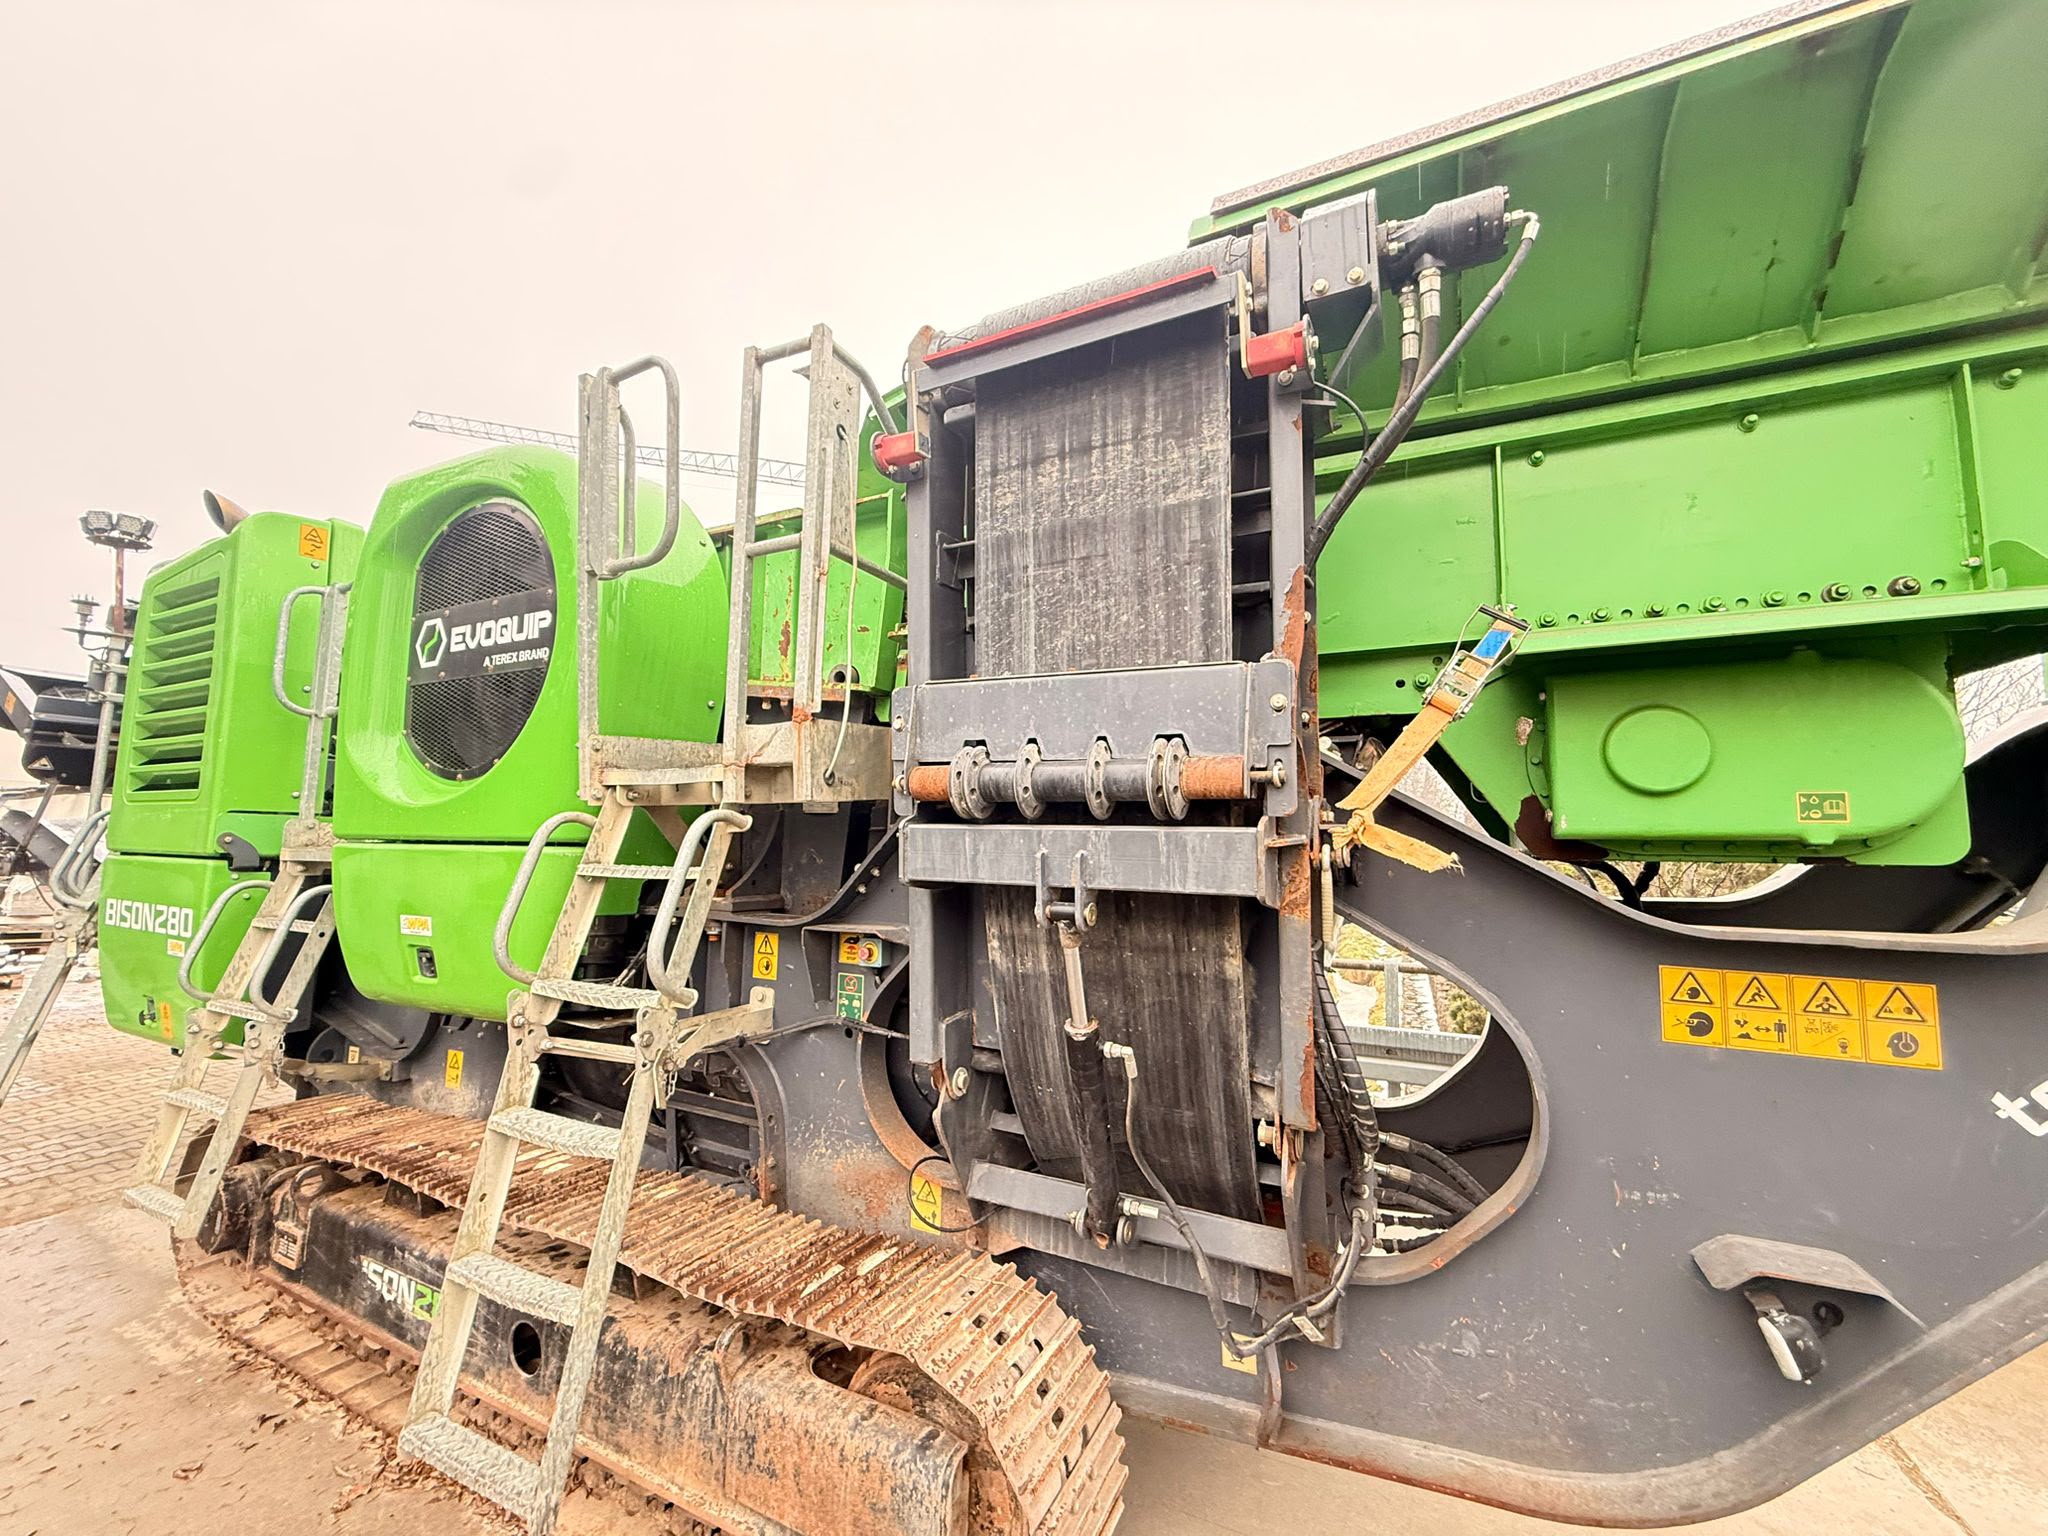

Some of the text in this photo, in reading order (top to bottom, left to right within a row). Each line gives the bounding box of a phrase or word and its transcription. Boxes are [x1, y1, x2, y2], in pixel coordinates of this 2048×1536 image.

[449, 609, 553, 653] EVOQUIP
[483, 647, 550, 667] A TEREX BRAND
[105, 897, 194, 939] BISON280
